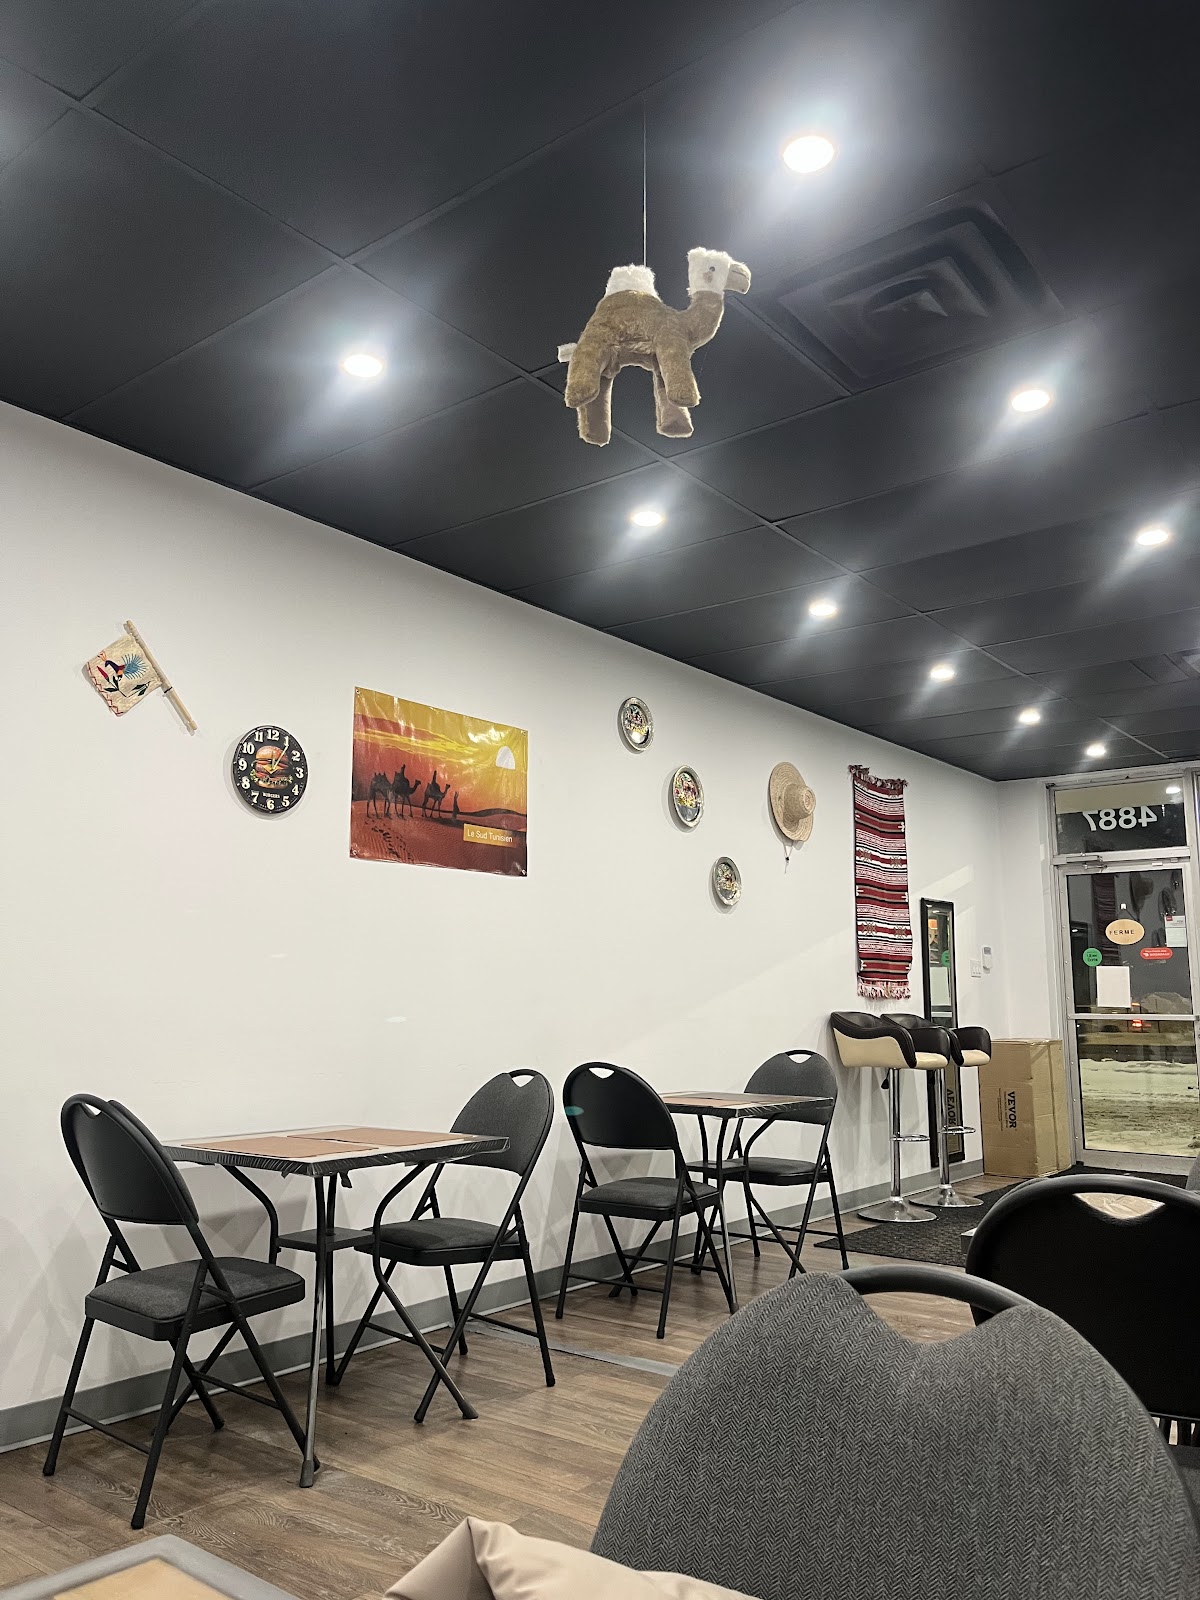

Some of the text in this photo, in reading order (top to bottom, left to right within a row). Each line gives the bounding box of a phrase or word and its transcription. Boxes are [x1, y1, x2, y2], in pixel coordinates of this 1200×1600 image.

[255, 731, 264, 742] 11
[267, 729, 280, 741] 12
[284, 736, 289, 746] 1
[243, 742, 255, 755] 10
[292, 750, 301, 762] 2
[239, 758, 247, 771] 9
[296, 767, 304, 779] 3
[242, 776, 250, 789] 8
[292, 785, 299, 796] 4
[251, 791, 260, 804] 7
[282, 796, 290, 807] 5
[266, 798, 275, 810] 6
[467, 829, 513, 843] Le Sud Tunisien
[1008, 1091, 1017, 1128] VEVOR
